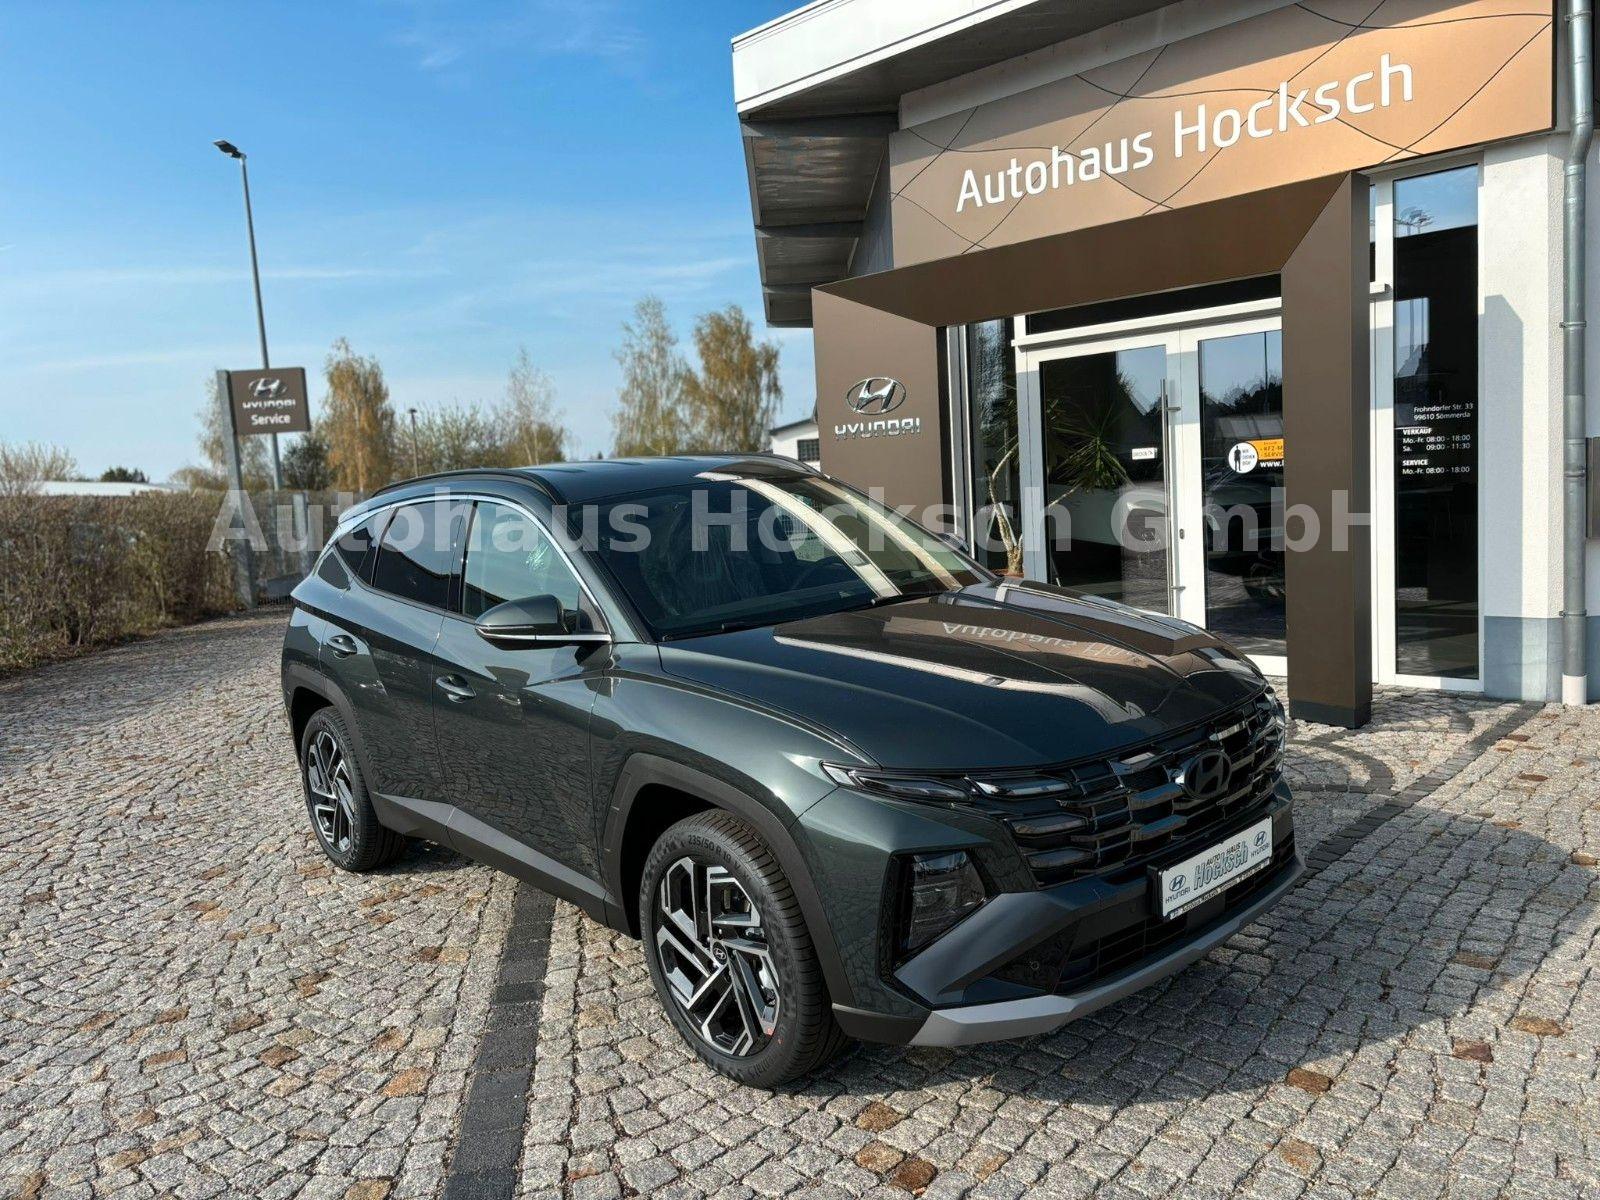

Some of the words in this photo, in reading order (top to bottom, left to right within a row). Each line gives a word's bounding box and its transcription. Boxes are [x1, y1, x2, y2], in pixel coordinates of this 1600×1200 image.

[955, 131, 1154, 212] Autohaus
[1173, 52, 1413, 159] Hocksch
[250, 414, 291, 426] Service
[834, 417, 921, 440] HYUNDAI
[1426, 435, 1446, 443] 08:00
[1426, 443, 1446, 451] 09:00
[1402, 459, 1429, 467] SERVICE
[1193, 840, 1249, 891] Hocksch
[1165, 886, 1191, 904] HYUNDAI
